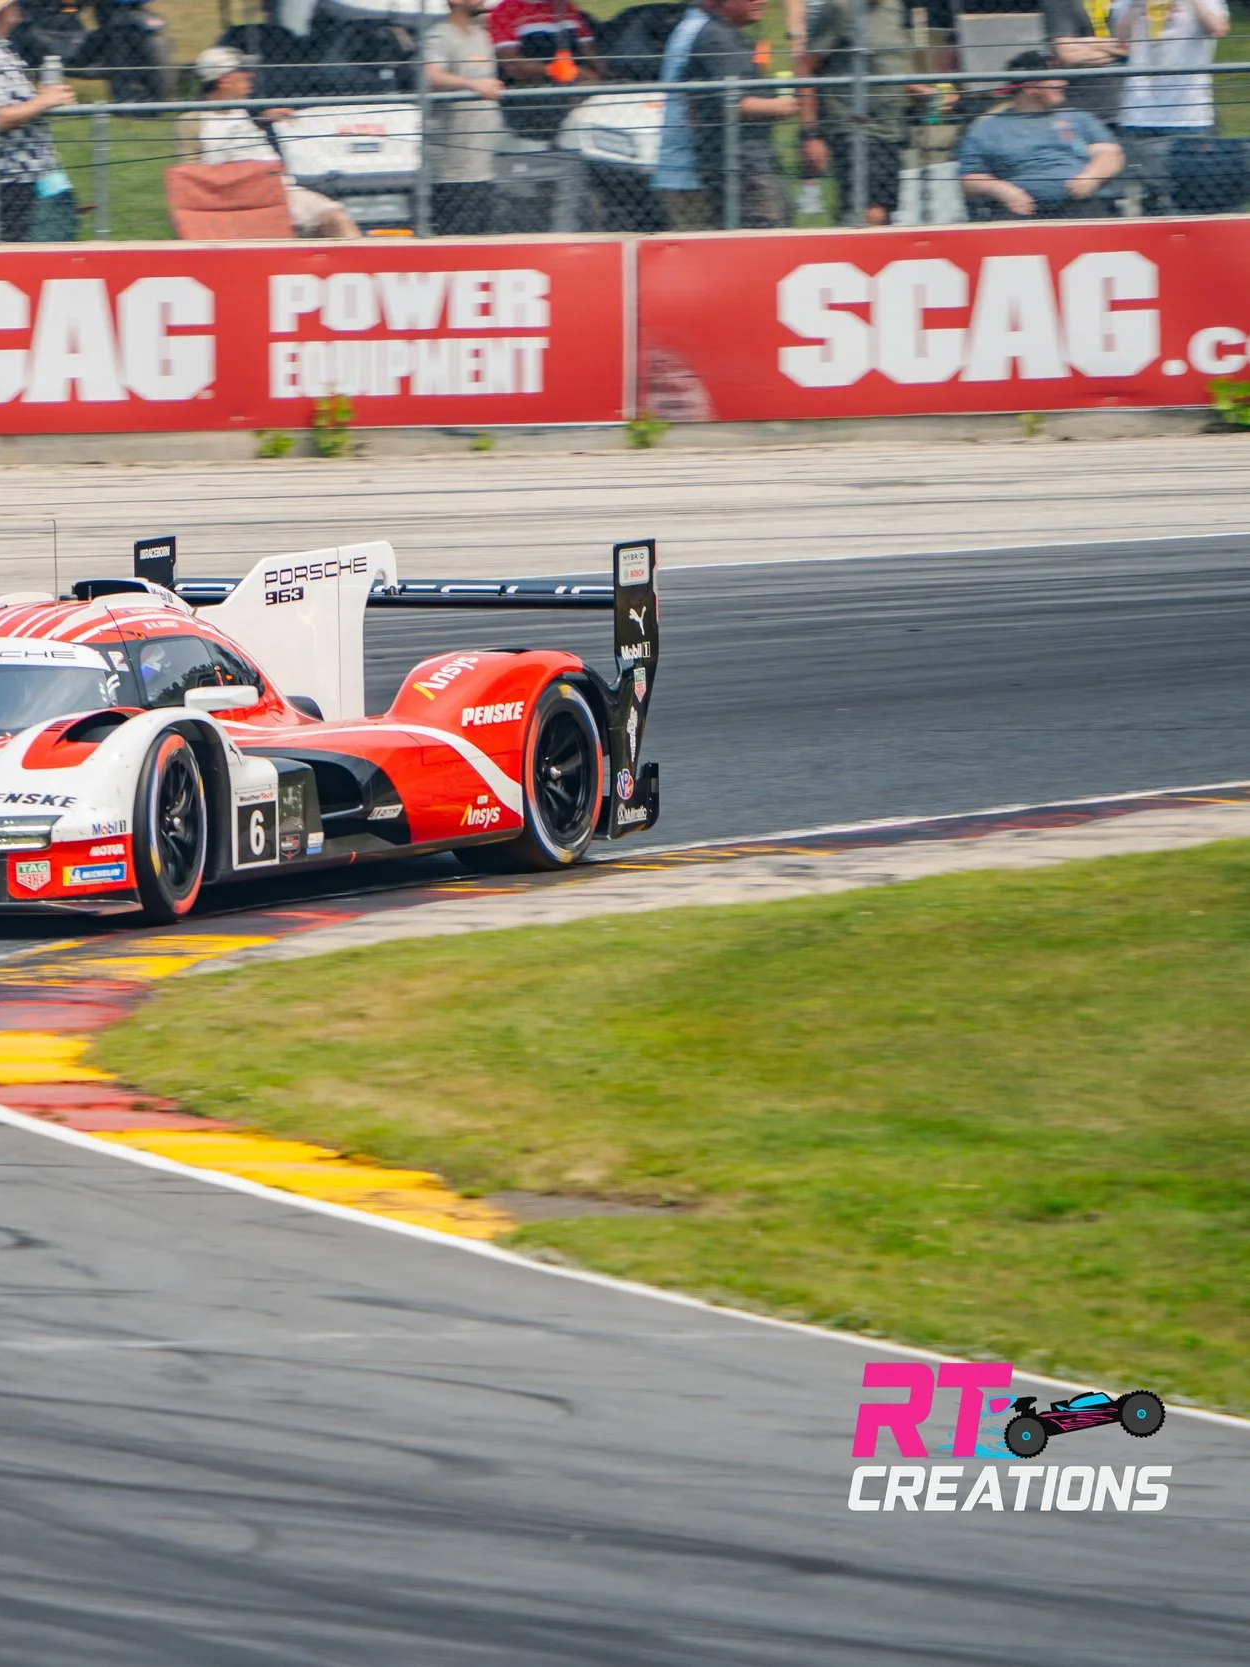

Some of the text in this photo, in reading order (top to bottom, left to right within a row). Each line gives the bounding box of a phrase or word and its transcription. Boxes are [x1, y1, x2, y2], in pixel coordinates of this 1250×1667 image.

[269, 269, 550, 332] POWER
[269, 337, 549, 398] EQUIPMENT
[622, 552, 645, 560] HYBRID
[264, 556, 367, 588] PORSCHE
[265, 586, 304, 606] 963
[621, 641, 651, 660] Mobil 1
[412, 656, 479, 700] Ansys
[461, 701, 524, 727] PENSKE
[617, 768, 631, 799] VP
[460, 804, 501, 828] Ansys
[92, 823, 118, 835] Mobil
[250, 809, 266, 856] 6
[89, 844, 125, 857] MOTUL
[19, 861, 48, 873] TAG
